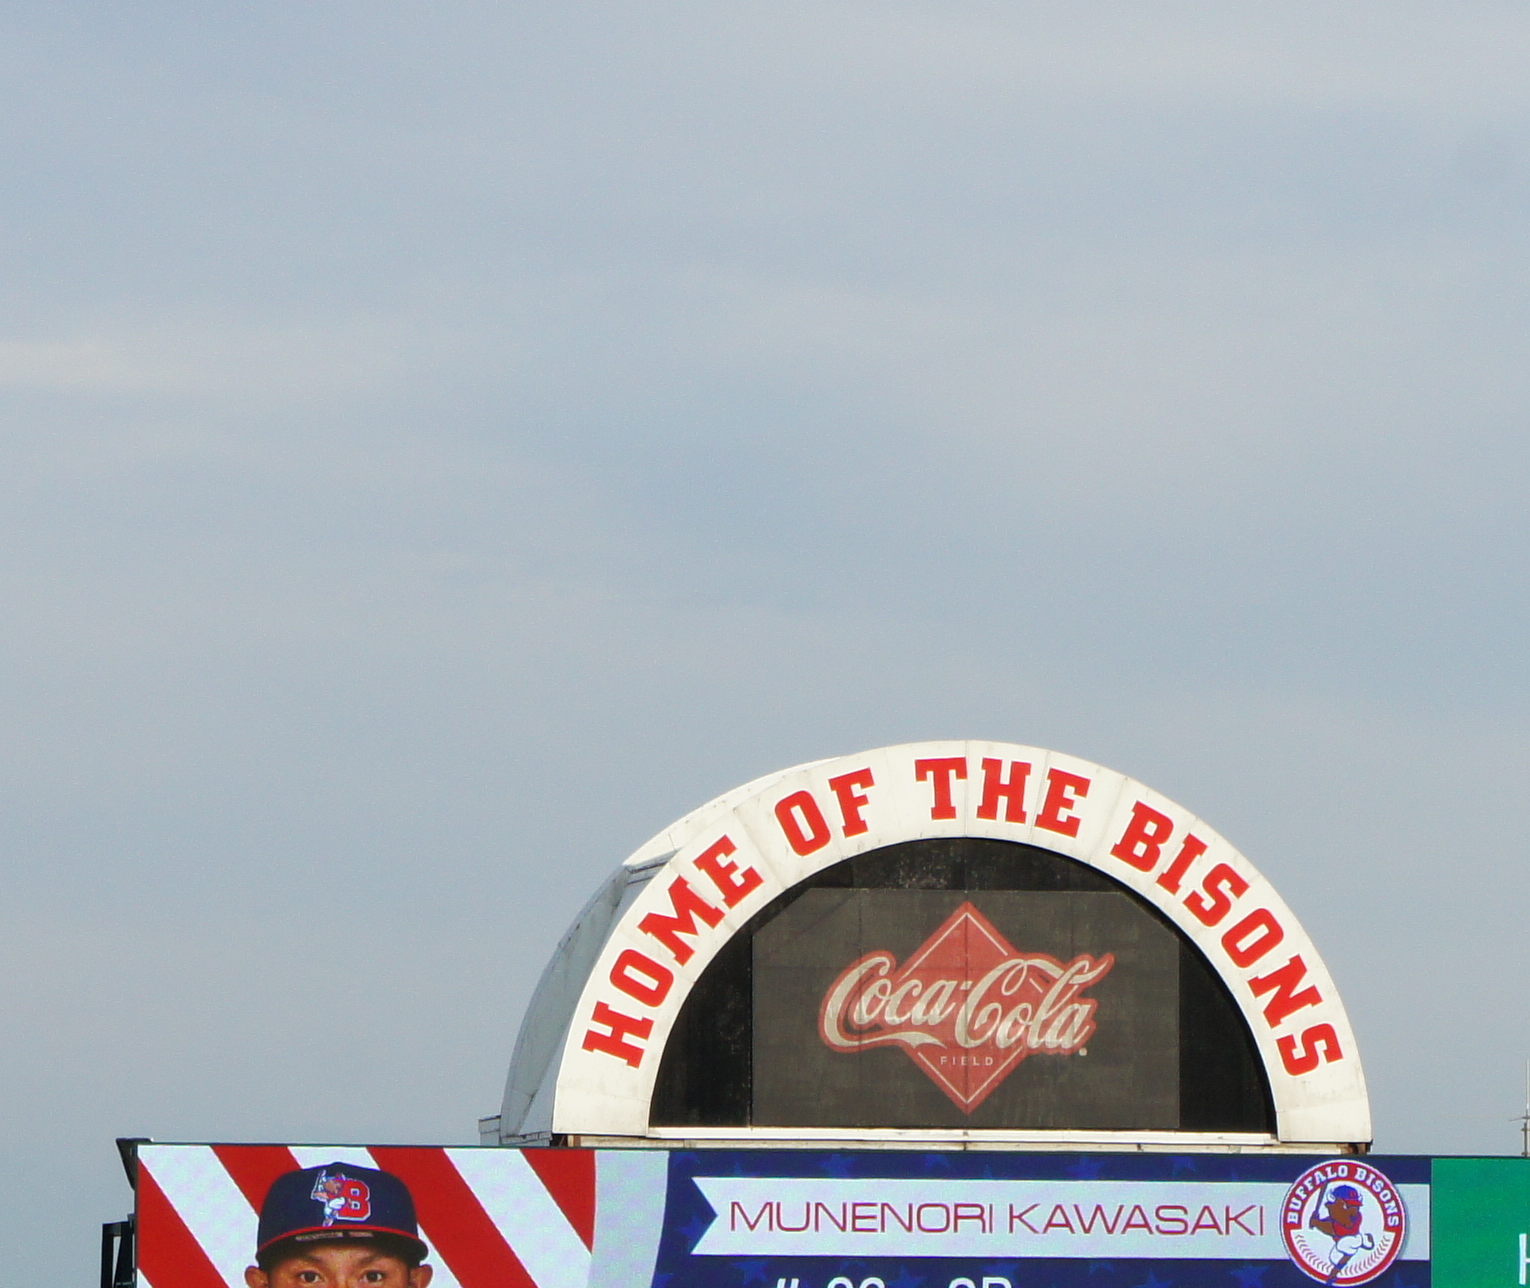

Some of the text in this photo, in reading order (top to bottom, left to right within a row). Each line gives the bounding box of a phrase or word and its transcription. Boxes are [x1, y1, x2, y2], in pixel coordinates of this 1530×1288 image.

[582, 757, 1344, 1079] HOME OF THE BISONS
[825, 953, 1114, 1053] Coca-Cola
[940, 1055, 994, 1067] FIELD
[730, 1201, 1265, 1236] MUNENORI KAWASAKI
[1287, 1165, 1399, 1227] BUFFALO BISONS
